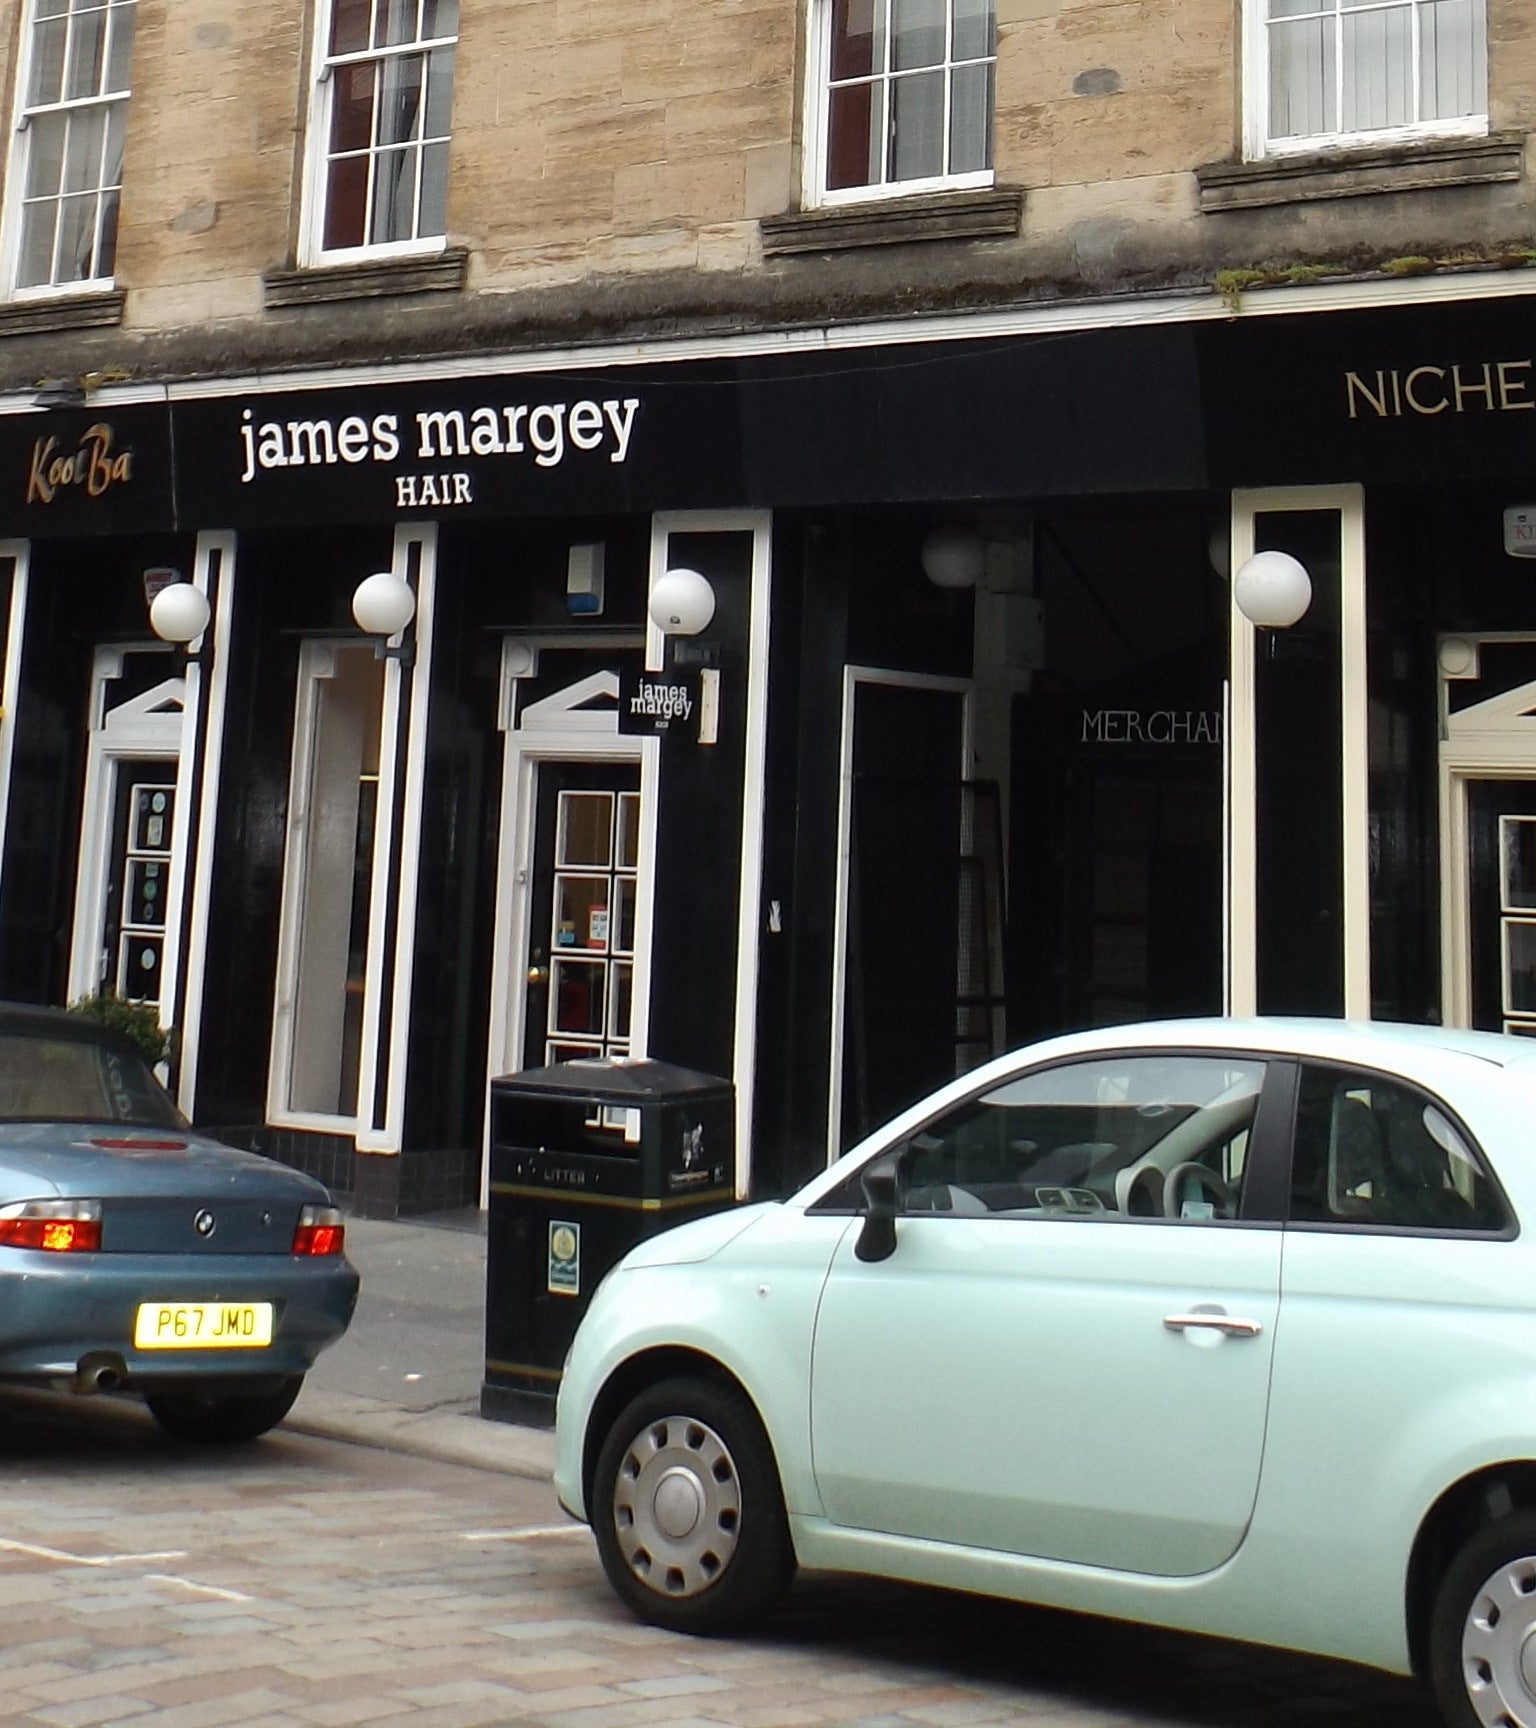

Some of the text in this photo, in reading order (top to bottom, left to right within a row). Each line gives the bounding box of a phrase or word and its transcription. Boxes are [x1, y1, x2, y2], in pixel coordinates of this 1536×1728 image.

[1344, 359, 1536, 418] NICHE
[240, 397, 640, 482] james margey
[395, 473, 474, 507] HAIR
[638, 678, 688, 701] james
[630, 697, 693, 721] margey
[544, 1169, 585, 1184] LITTER
[158, 1308, 254, 1337] P67 JMD
